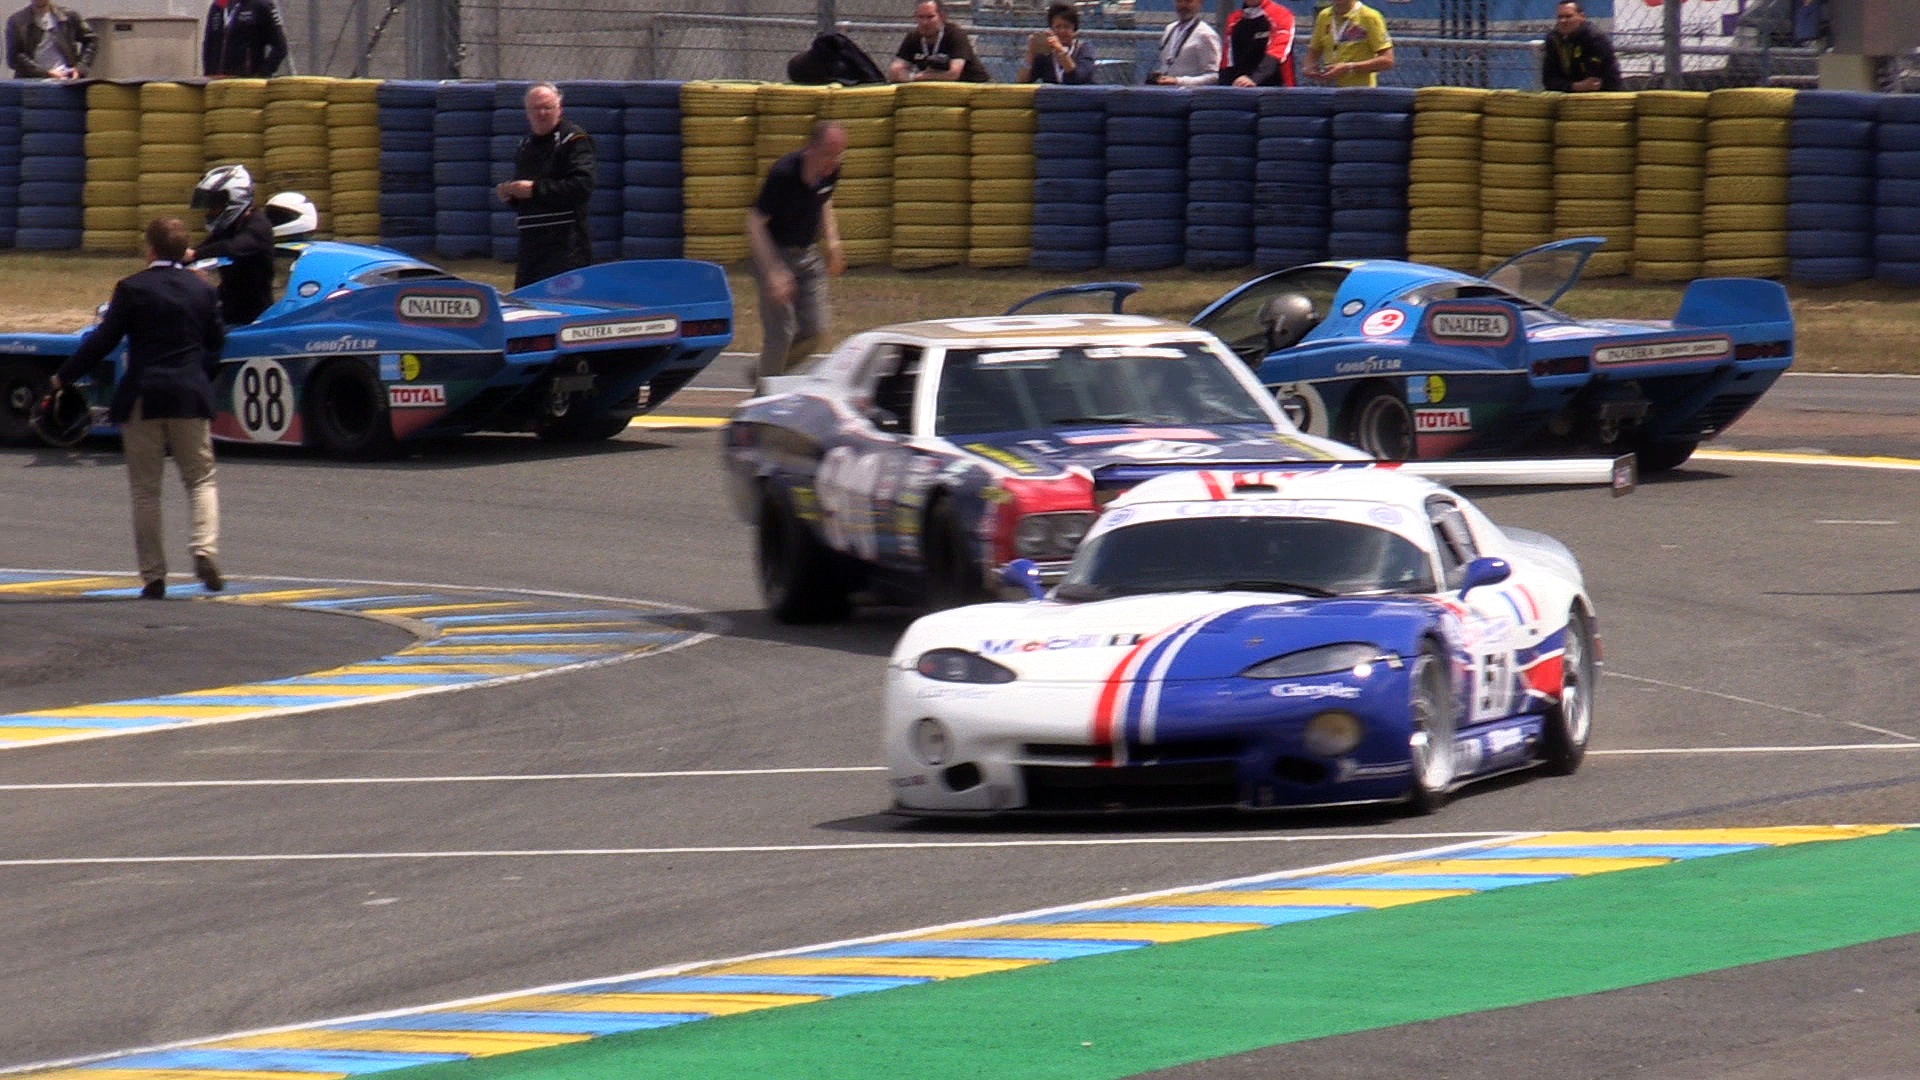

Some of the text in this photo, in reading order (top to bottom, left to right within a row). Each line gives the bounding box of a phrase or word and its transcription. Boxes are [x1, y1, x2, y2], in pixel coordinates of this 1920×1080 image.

[408, 299, 473, 315] INALTERA
[1440, 316, 1500, 333] INALTERA
[244, 367, 284, 431] 88
[391, 388, 443, 403] TOTAL
[1416, 411, 1469, 428] TOTAL
